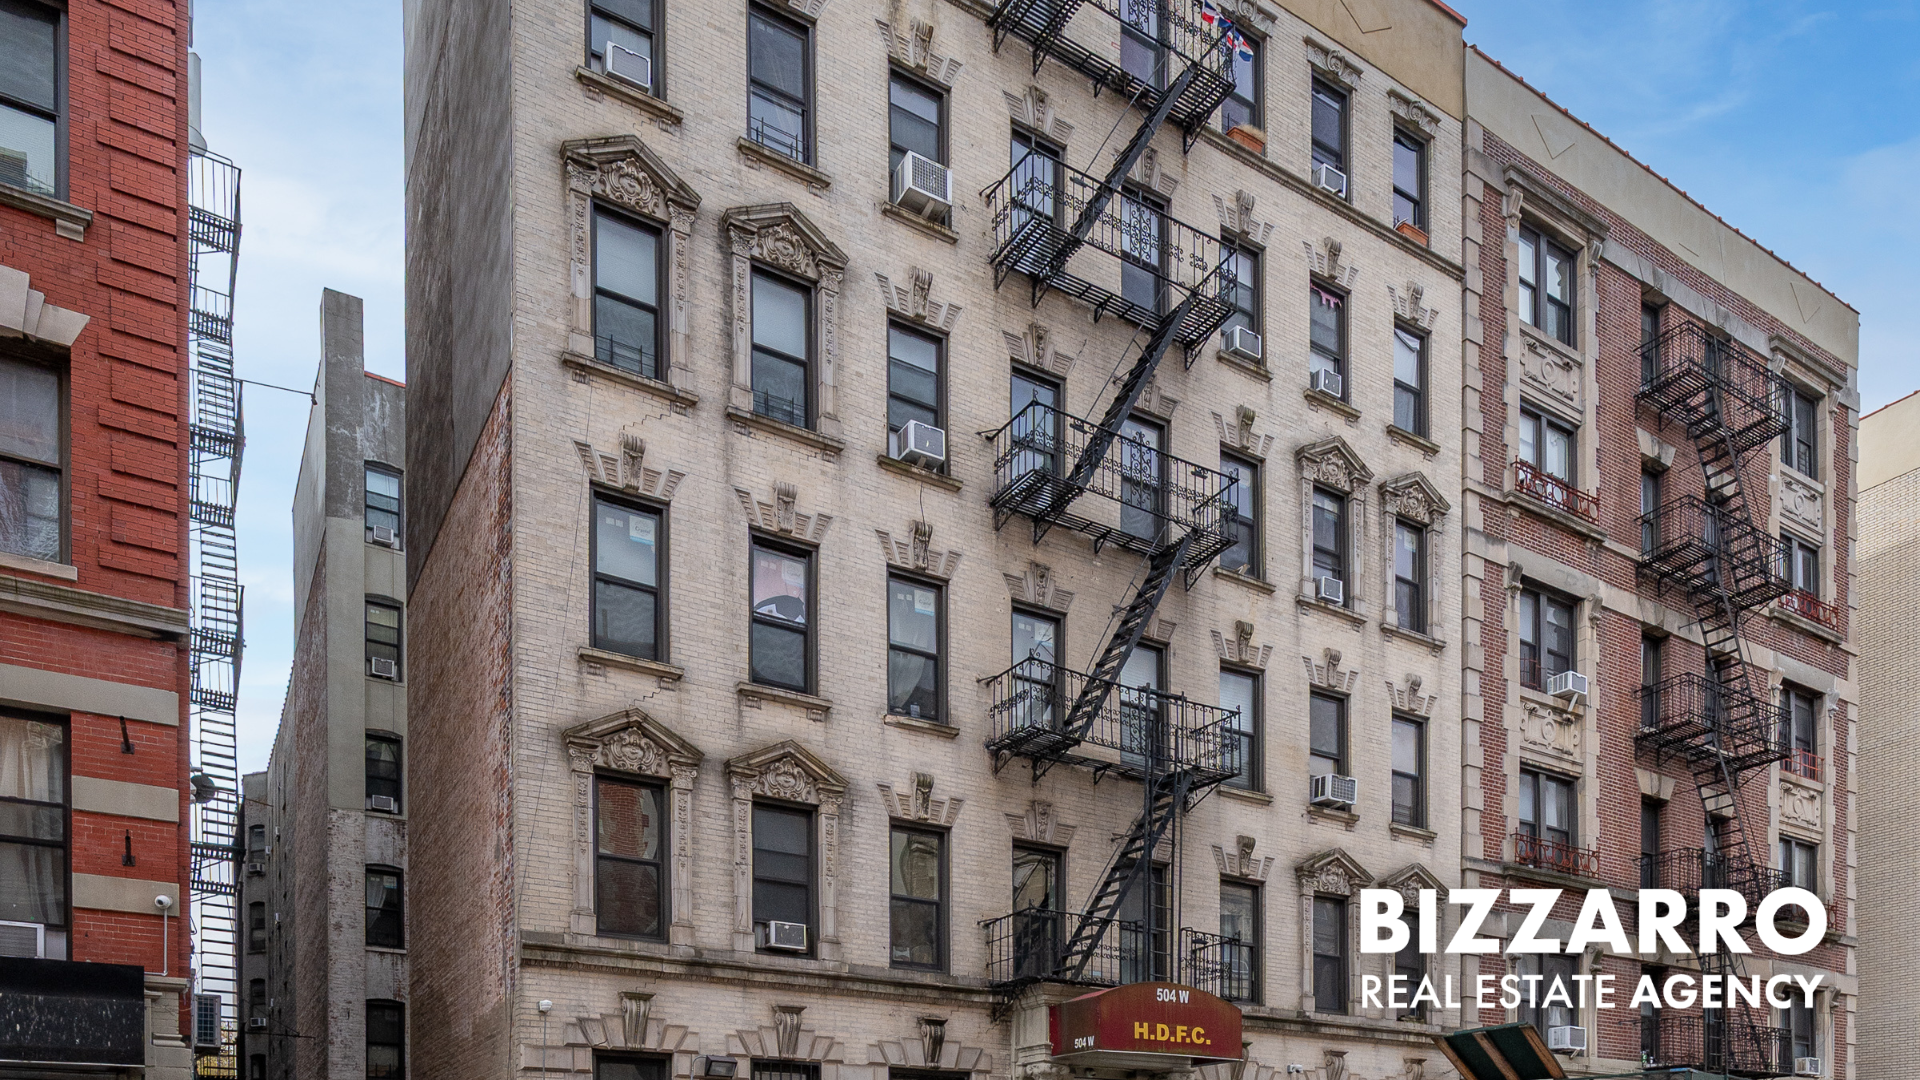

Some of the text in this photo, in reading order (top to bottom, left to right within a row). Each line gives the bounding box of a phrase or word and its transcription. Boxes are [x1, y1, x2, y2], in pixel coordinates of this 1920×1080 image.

[1156, 987, 1190, 1004] 504 W
[1134, 1021, 1212, 1045] H.D.F.C.
[1074, 1035, 1095, 1049] 504 W
